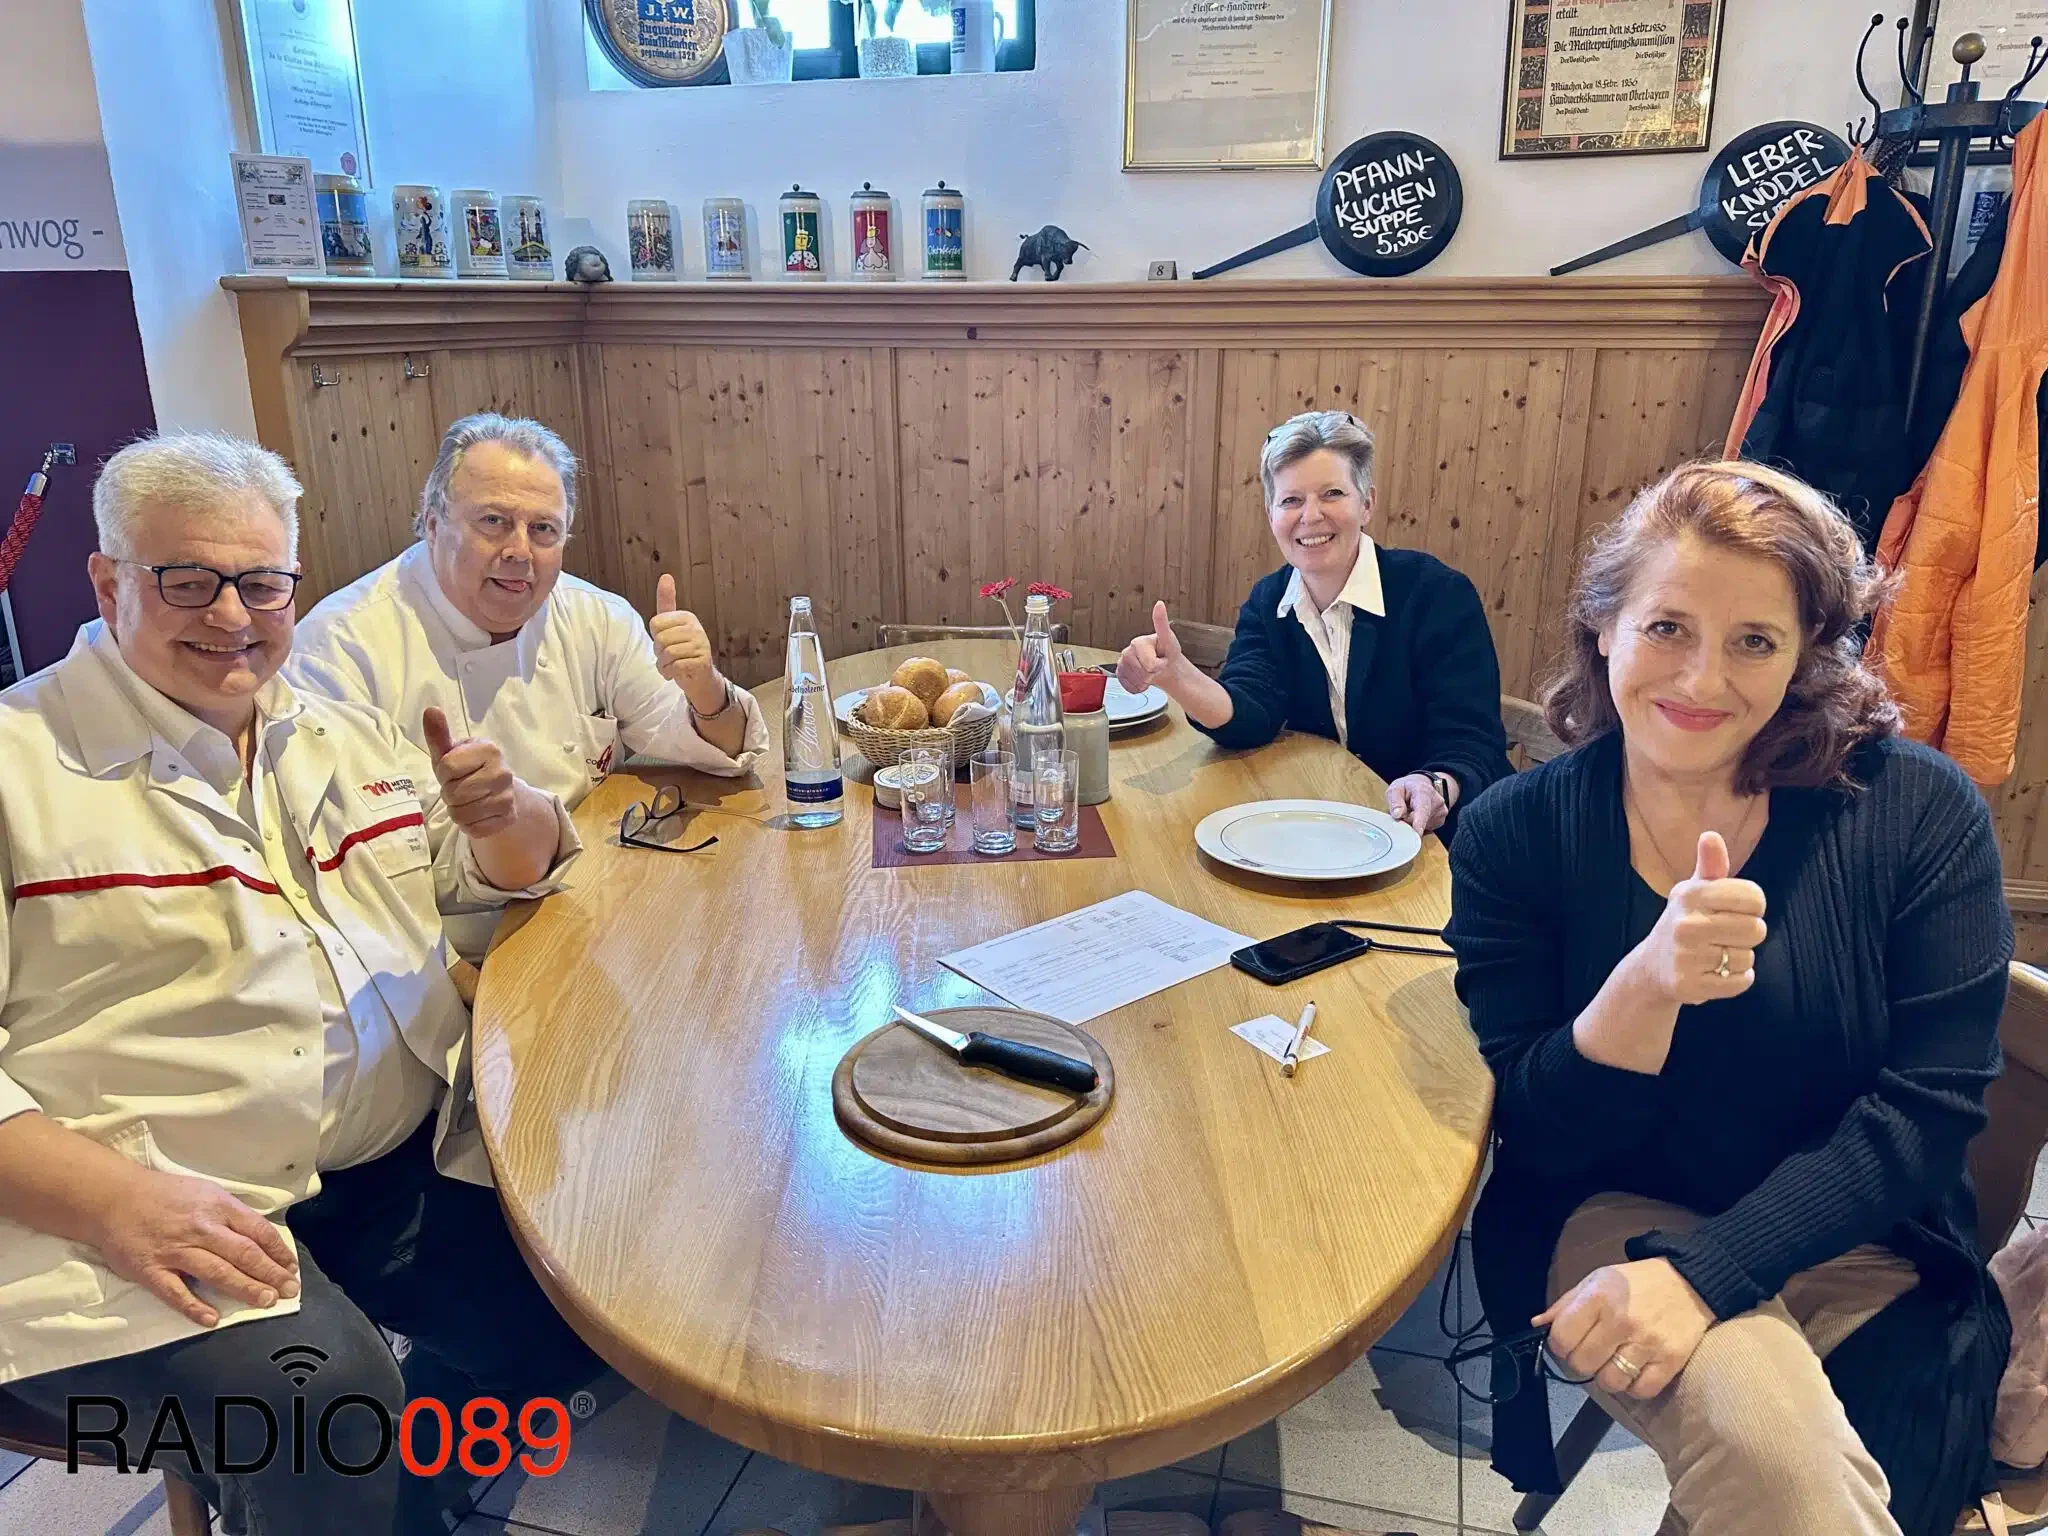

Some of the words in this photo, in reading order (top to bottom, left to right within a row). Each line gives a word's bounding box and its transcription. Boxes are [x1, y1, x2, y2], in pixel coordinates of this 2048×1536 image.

[1332, 150, 1435, 206] PFANN-
[1727, 129, 1825, 188] LEBER-
[1335, 177, 1436, 228] KUCHEN
[1721, 157, 1838, 221] KNÖDEL
[1350, 205, 1423, 238] SUPPE
[1156, 265, 1164, 276] 8
